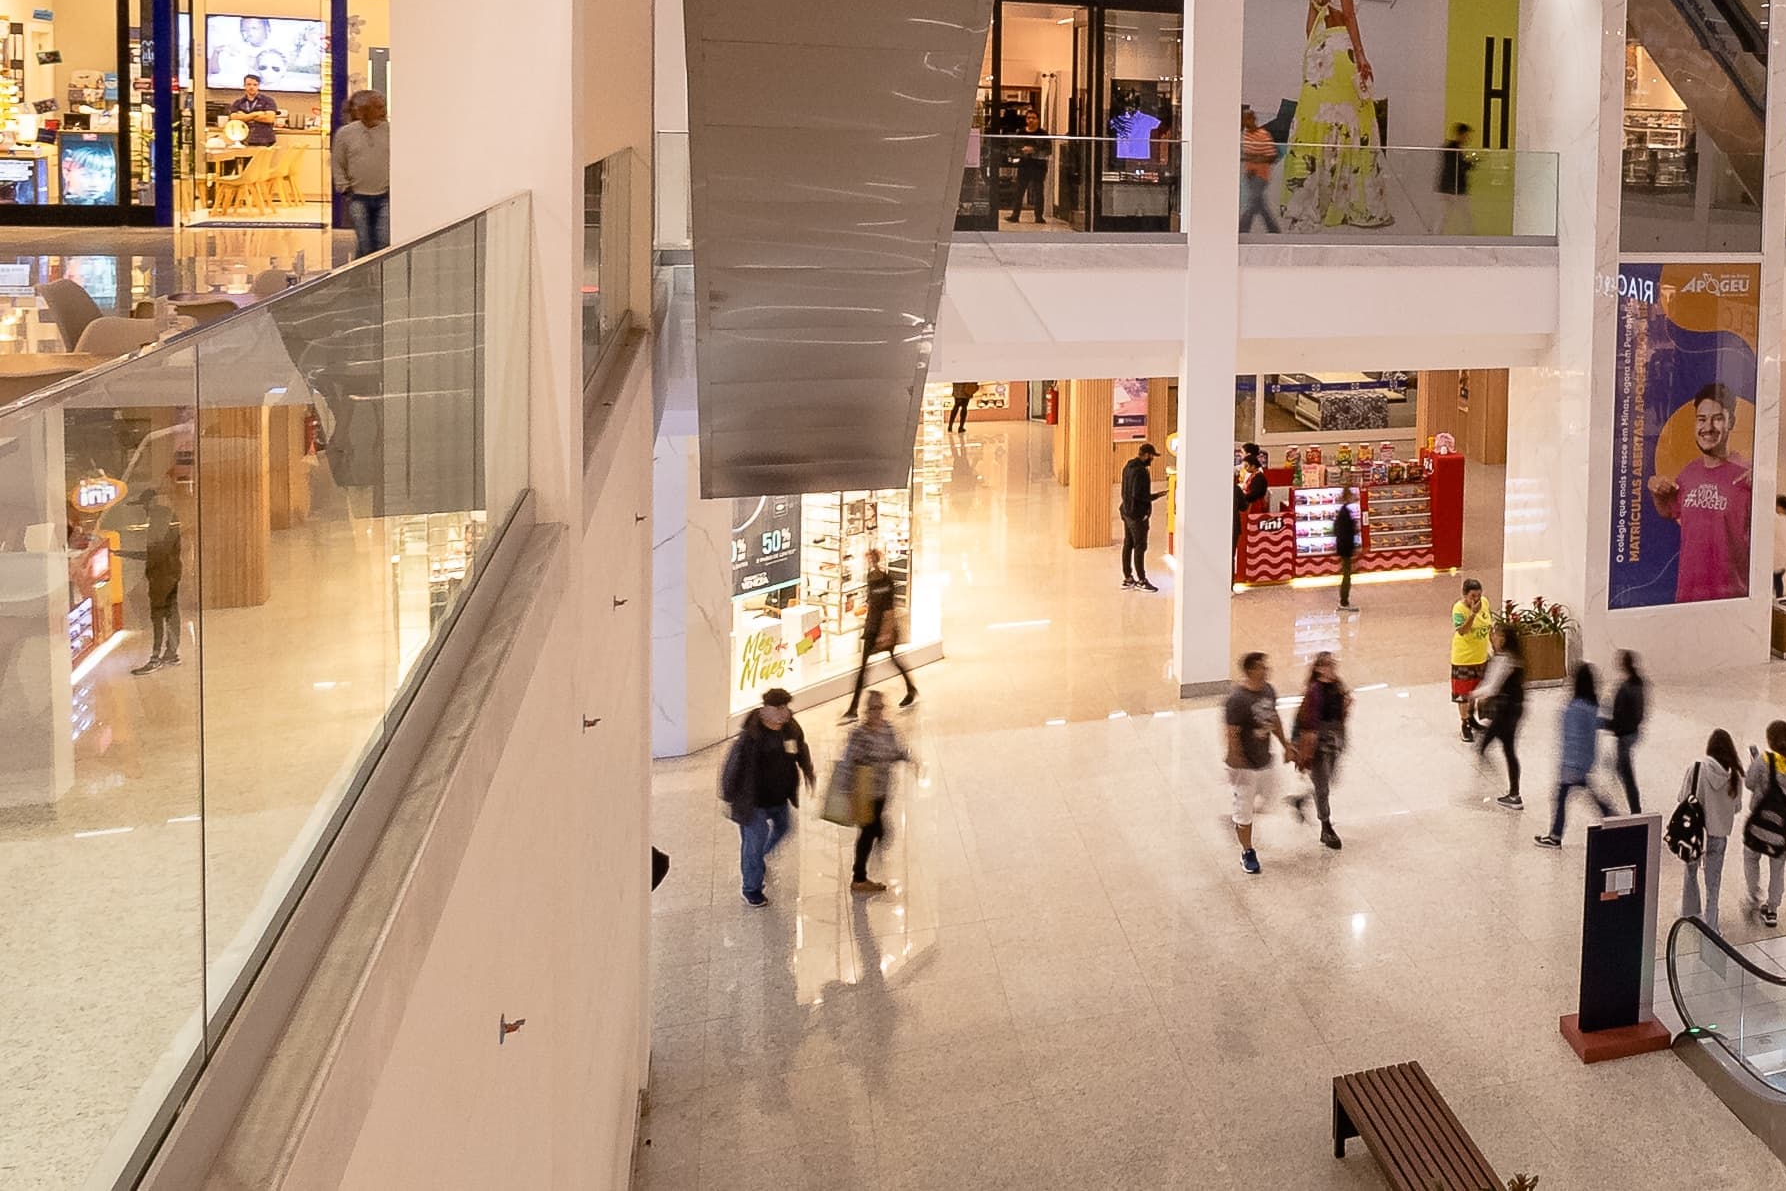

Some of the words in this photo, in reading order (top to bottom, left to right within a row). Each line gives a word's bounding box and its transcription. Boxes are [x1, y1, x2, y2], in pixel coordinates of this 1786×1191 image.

[1680, 273, 1750, 297] APOGEU
[1624, 349, 1631, 364] em
[1623, 366, 1632, 395] agora
[1621, 427, 1629, 442] em
[1618, 475, 1628, 497] mais
[1619, 498, 1628, 518] que
[1628, 478, 1642, 563] MATRÍCULAS
[1617, 518, 1628, 554] colégio
